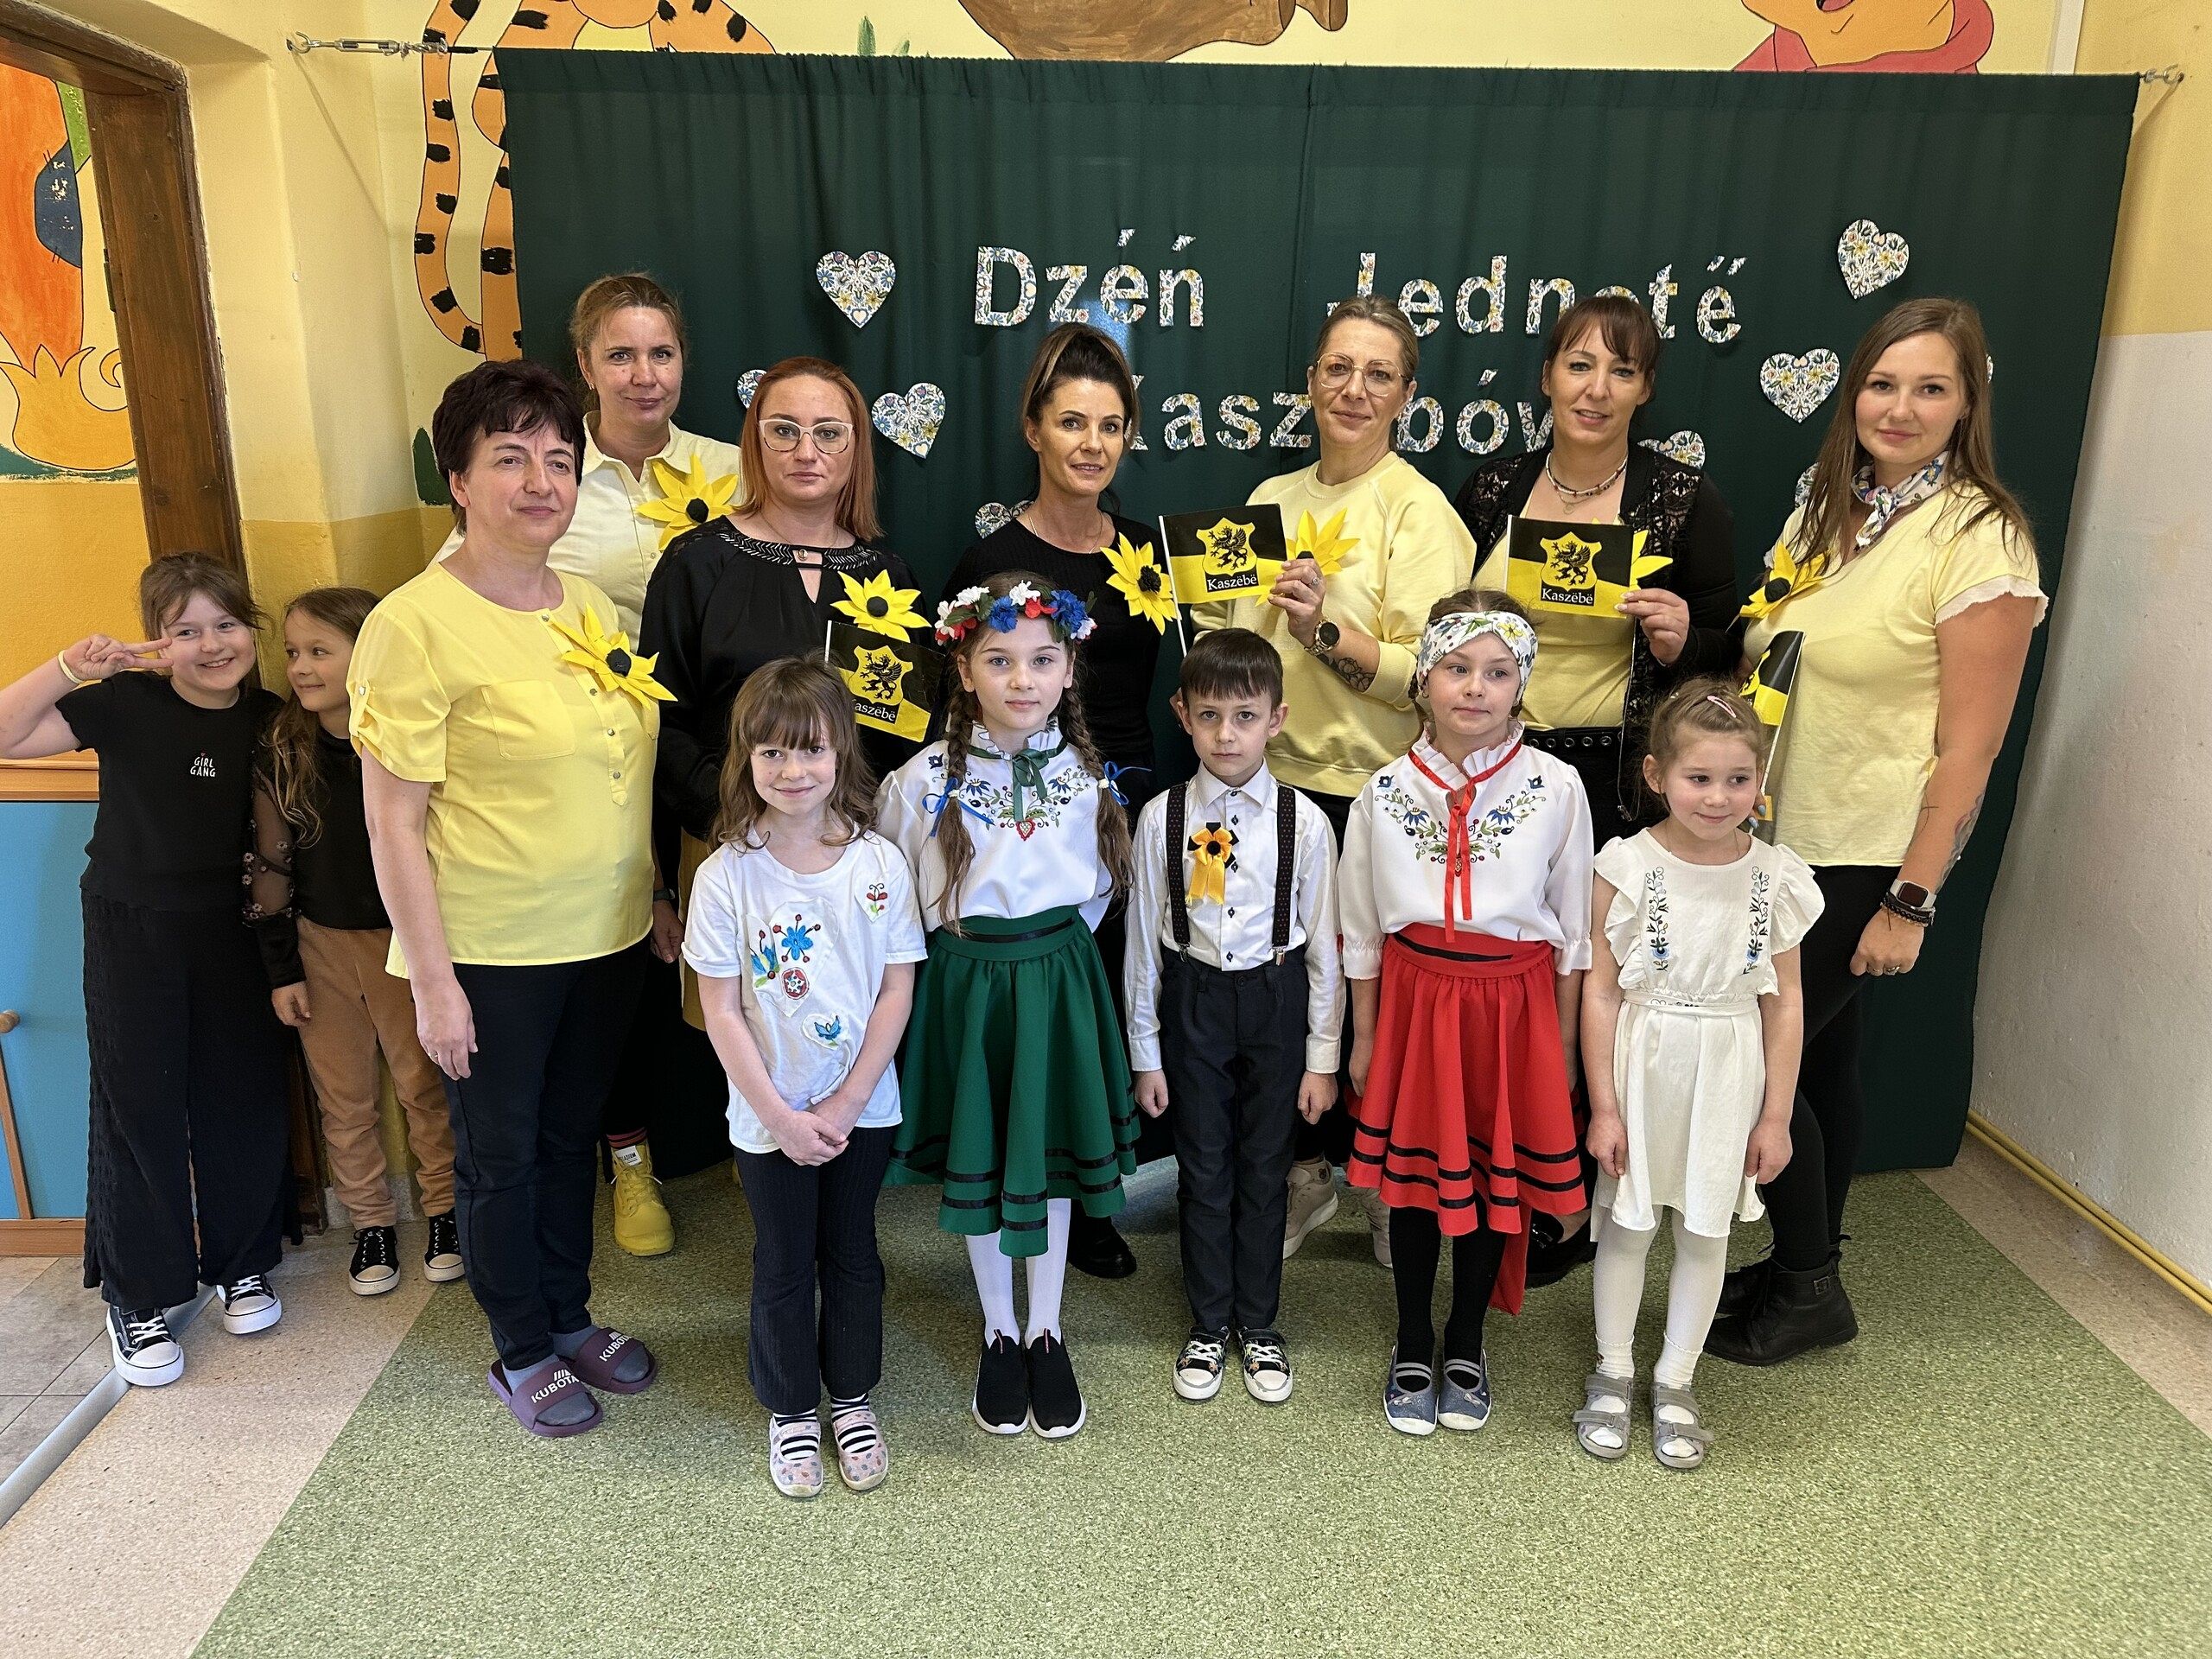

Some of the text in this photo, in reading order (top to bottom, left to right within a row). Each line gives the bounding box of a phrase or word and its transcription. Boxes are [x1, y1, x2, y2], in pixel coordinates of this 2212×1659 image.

[975, 229, 1204, 327] Dzéń
[1207, 574, 1257, 591] Kaszëbë
[1541, 588, 1593, 605] Kaszëbë
[854, 699, 896, 721] aszëbë
[194, 756, 214, 768] GIRL
[190, 766, 216, 778] GANG
[531, 1375, 580, 1404] KUBOTA
